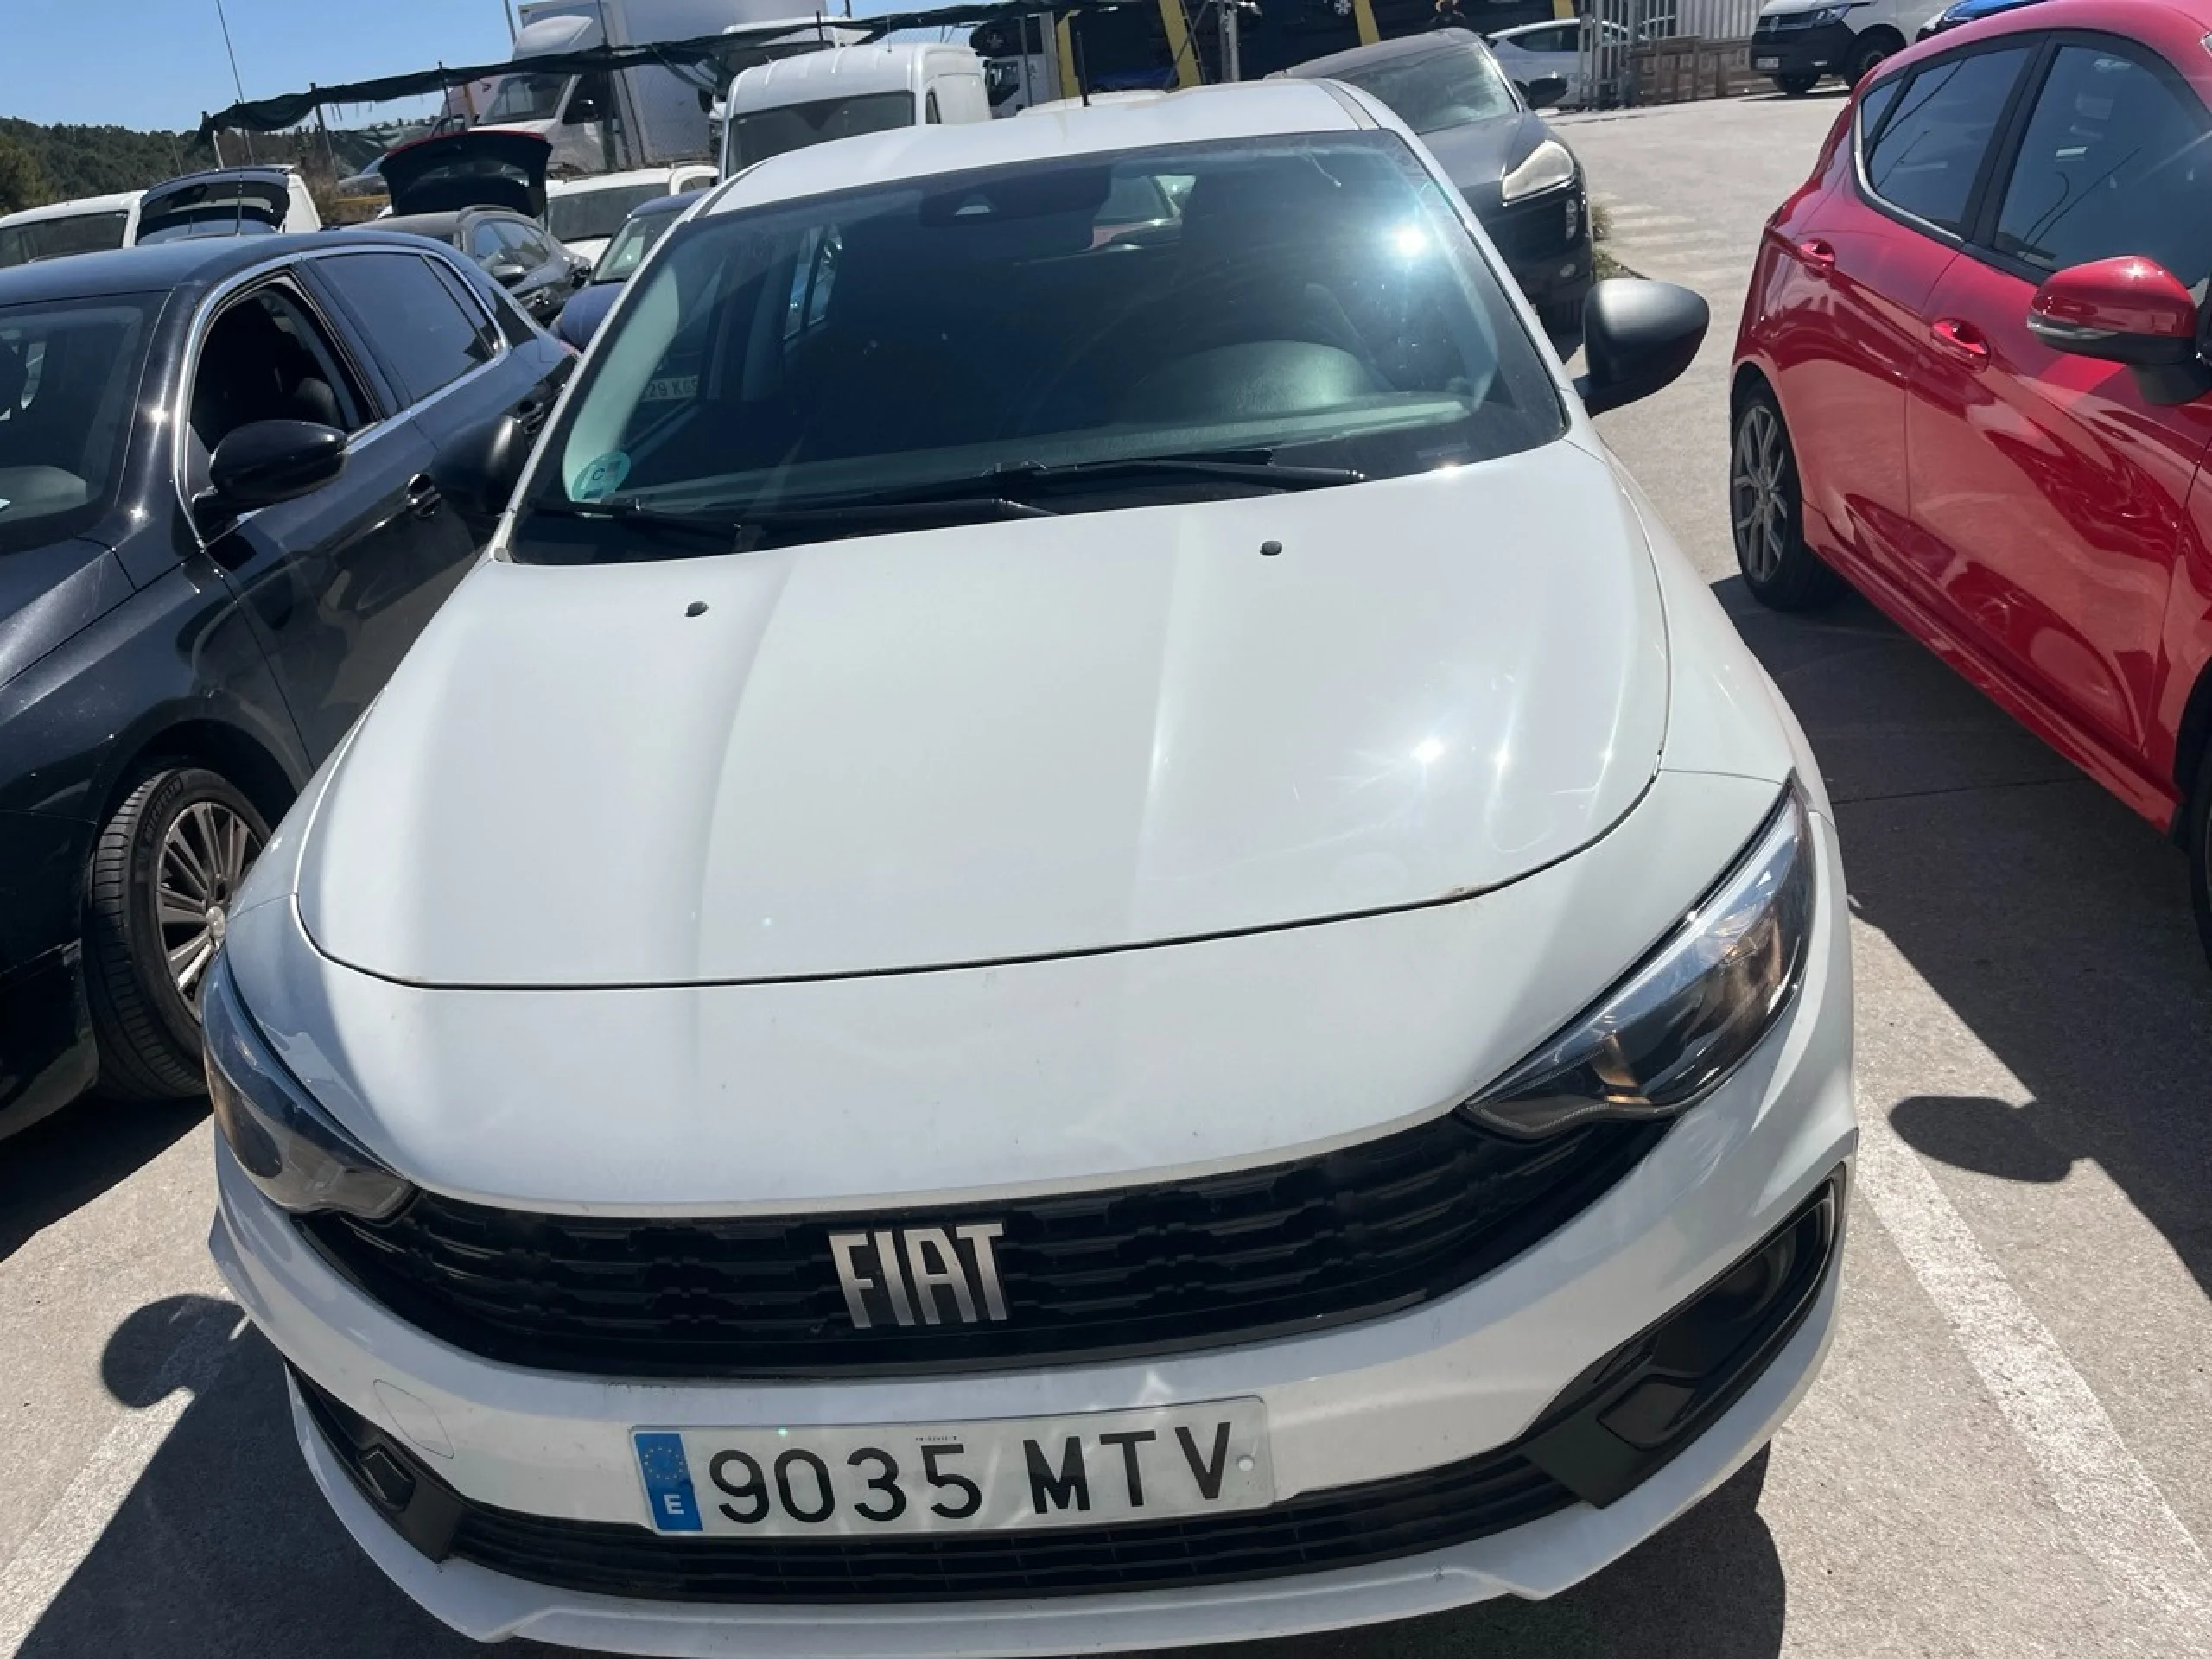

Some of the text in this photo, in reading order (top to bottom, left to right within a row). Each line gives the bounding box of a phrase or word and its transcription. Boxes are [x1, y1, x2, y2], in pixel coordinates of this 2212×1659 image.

[830, 1223, 1008, 1329] FIAT
[663, 1493, 685, 1515] E
[709, 1422, 1230, 1524] 9035 MTV
